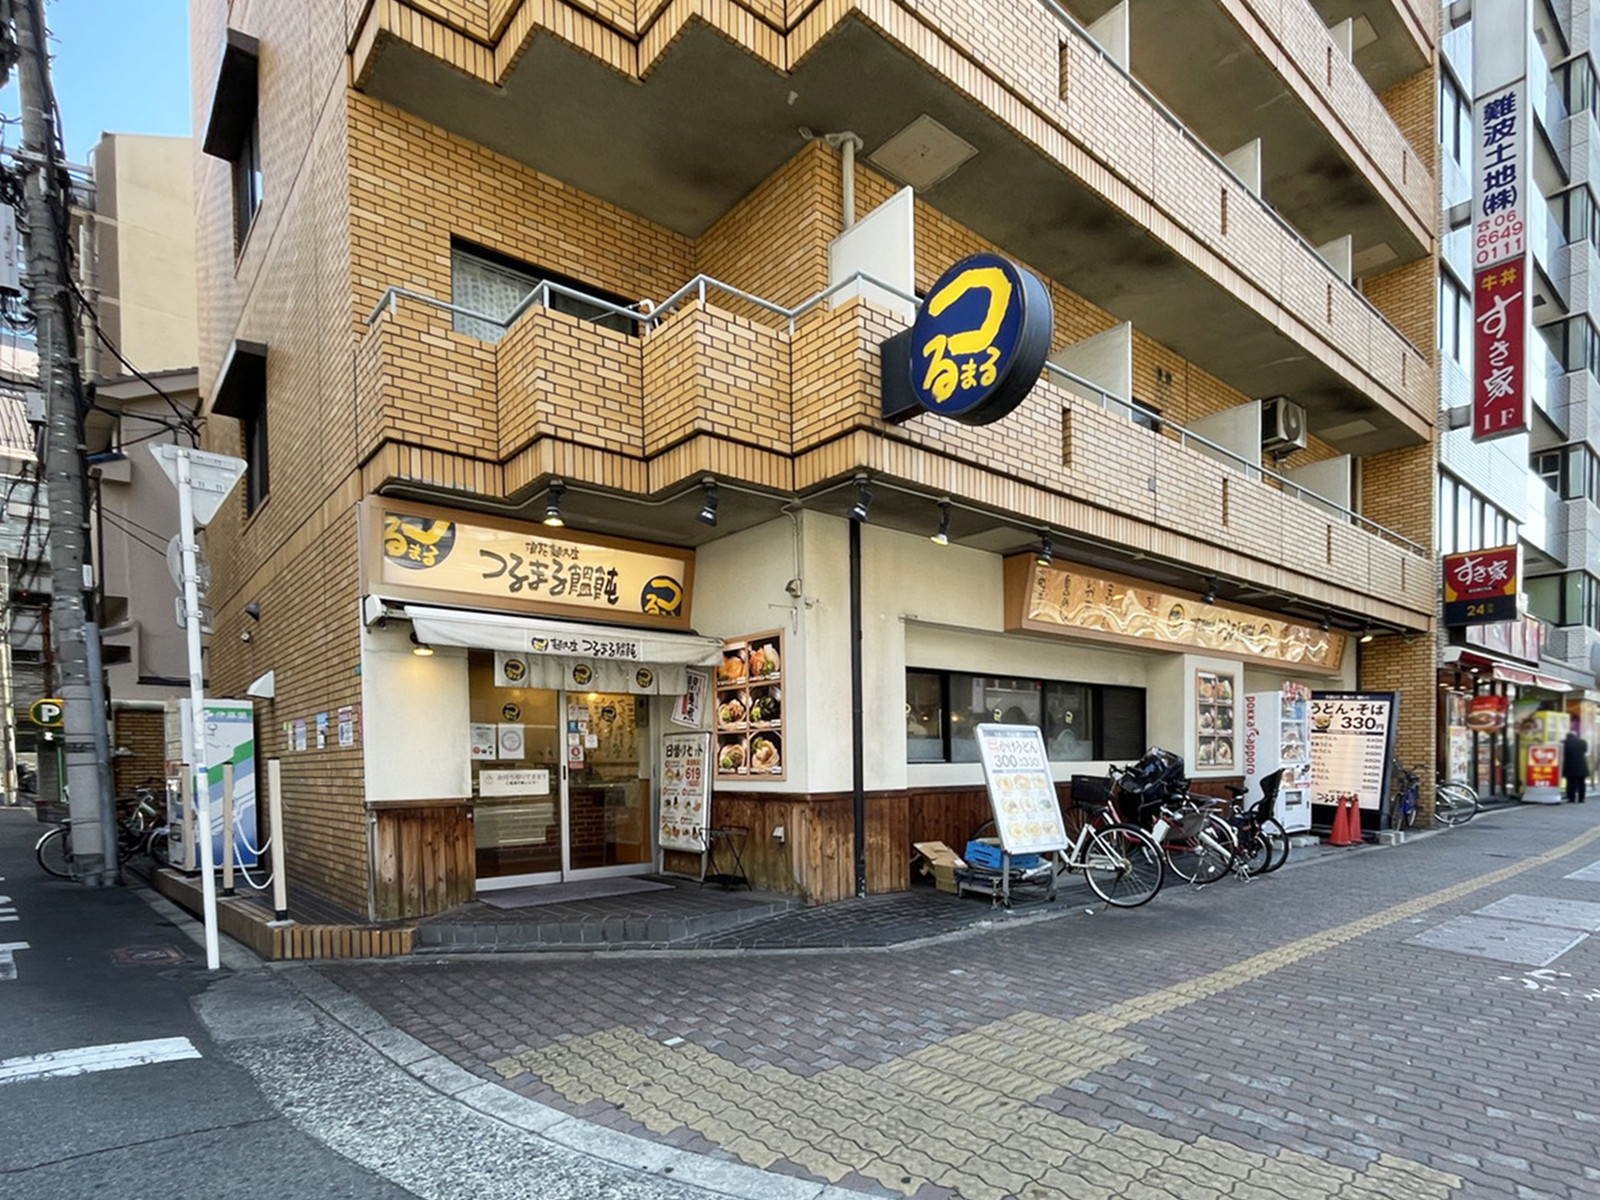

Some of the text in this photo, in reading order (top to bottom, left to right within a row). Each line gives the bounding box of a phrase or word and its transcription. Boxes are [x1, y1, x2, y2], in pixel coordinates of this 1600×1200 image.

[1494, 209, 1517, 228] 06
[1476, 220, 1524, 249] 6649
[1476, 237, 1523, 265] 0111
[1480, 267, 1518, 292] 牛丼
[1476, 290, 1523, 408] すき家
[1482, 408, 1516, 430] 1F
[479, 548, 620, 606] つるまる饂飩
[1453, 556, 1509, 586] すき家
[1466, 603, 1486, 618] 24
[41, 704, 60, 722] P
[994, 754, 1018, 768] 300
[685, 767, 701, 780] 619
